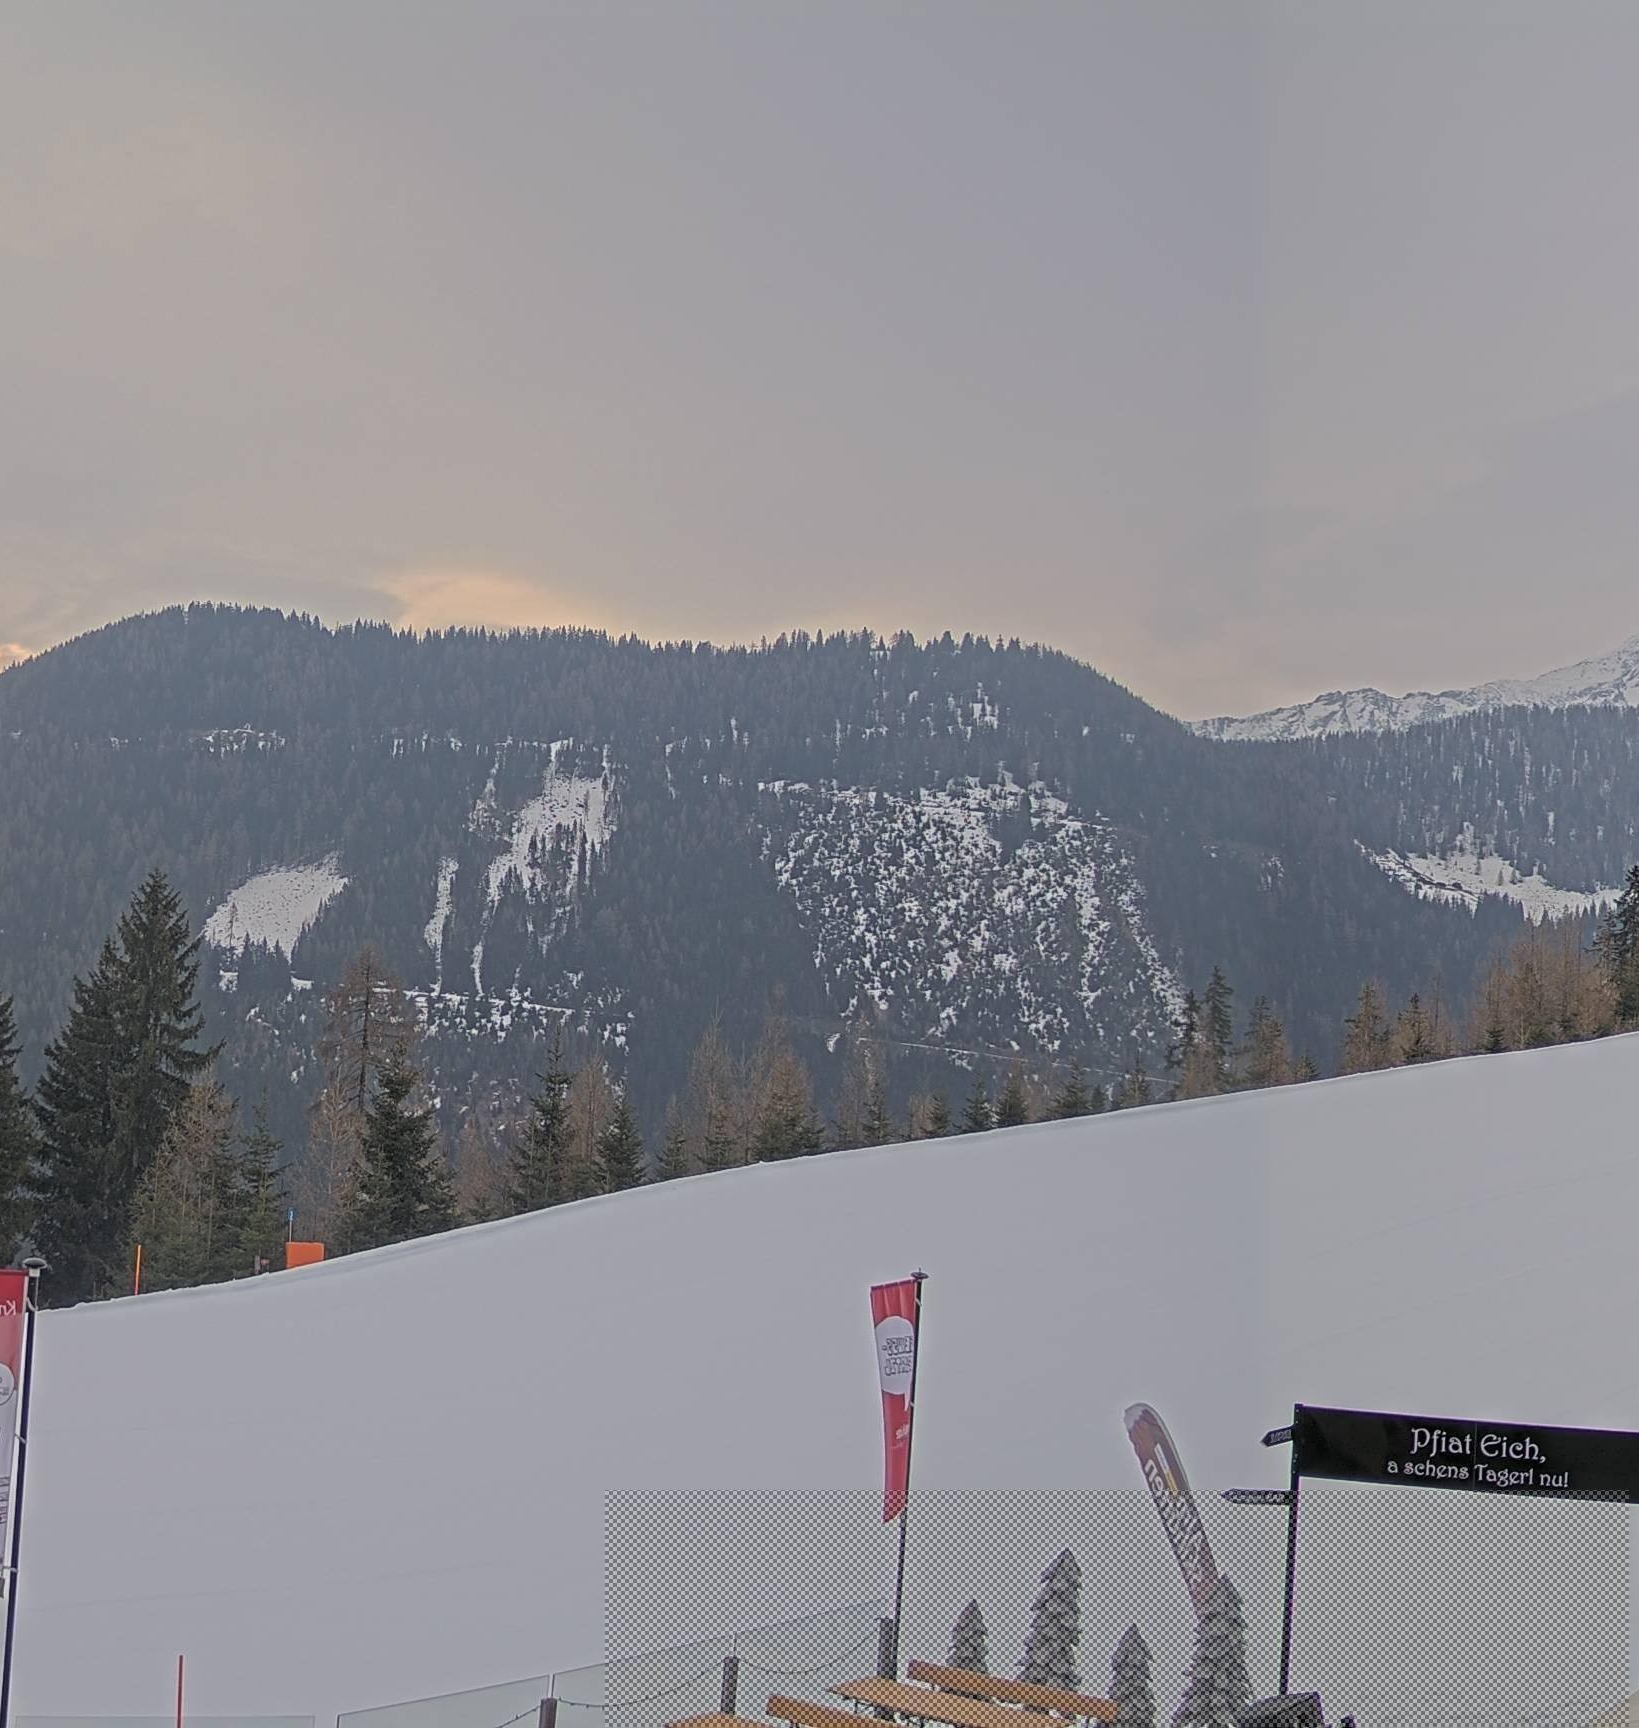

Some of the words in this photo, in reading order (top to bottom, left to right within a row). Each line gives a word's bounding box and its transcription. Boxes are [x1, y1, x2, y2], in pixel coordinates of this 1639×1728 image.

[1410, 1427, 1472, 1458] Pfiat
[1480, 1433, 1547, 1464] Eich,
[1387, 1460, 1399, 1474] a
[1403, 1459, 1469, 1480] schens
[1473, 1463, 1534, 1488] Tagerl
[1539, 1471, 1570, 1488] nu!
